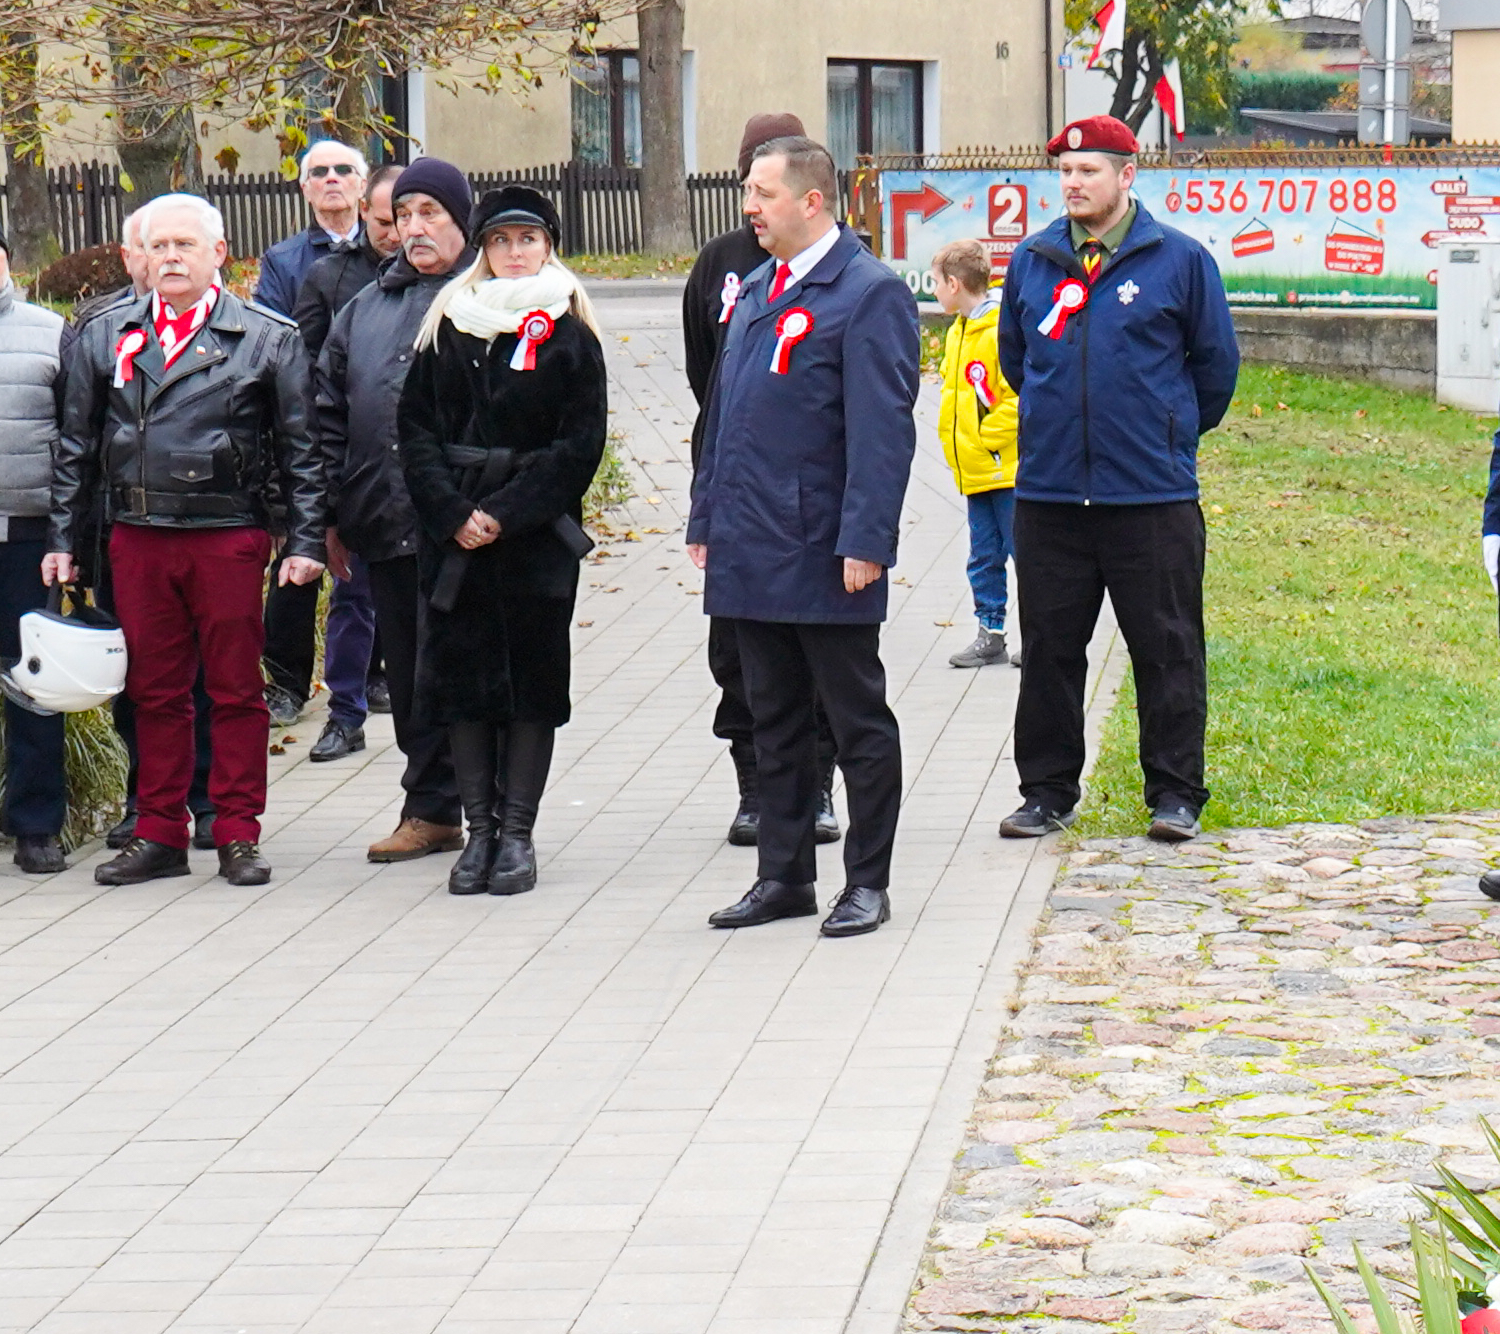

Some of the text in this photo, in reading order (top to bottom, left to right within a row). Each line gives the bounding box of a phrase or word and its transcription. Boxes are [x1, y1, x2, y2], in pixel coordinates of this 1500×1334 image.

[993, 186, 1024, 236] 2
[1185, 178, 1397, 214] 536 707 888
